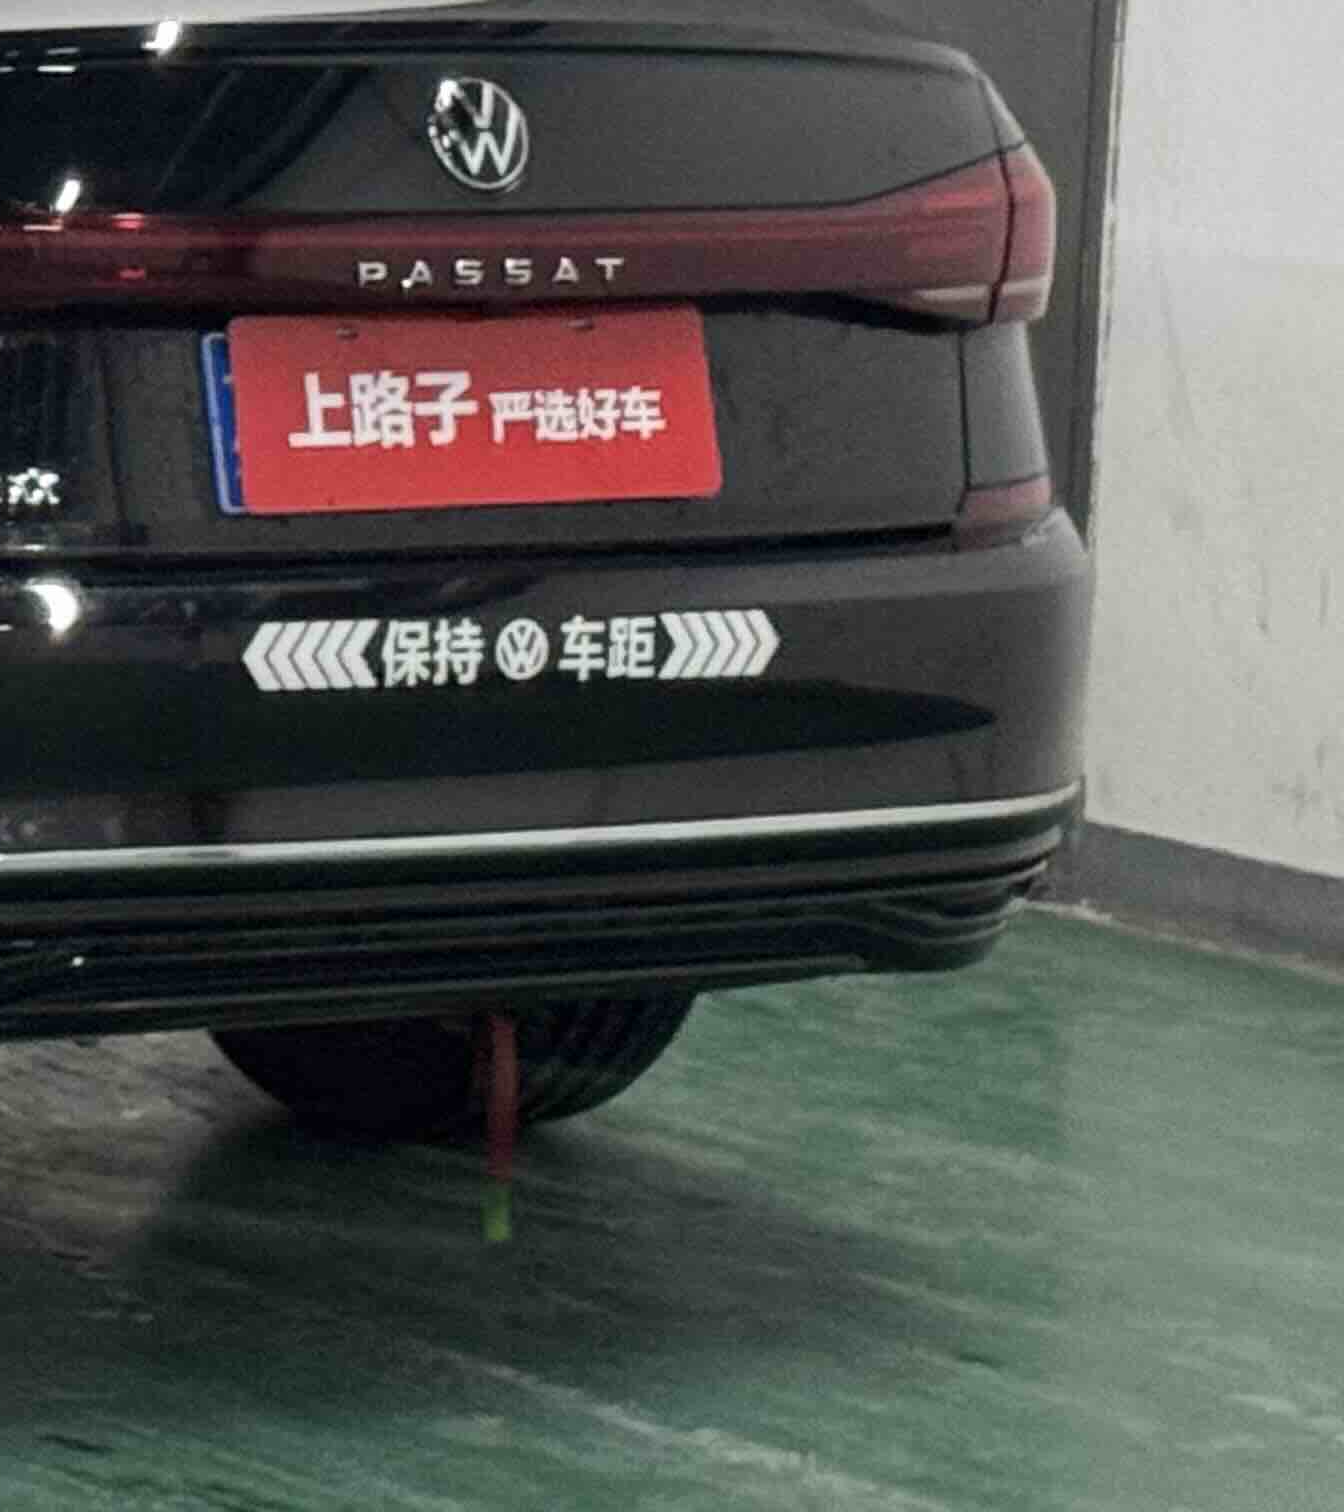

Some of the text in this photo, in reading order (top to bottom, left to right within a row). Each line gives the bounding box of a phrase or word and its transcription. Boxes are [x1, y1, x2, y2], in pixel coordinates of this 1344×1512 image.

[358, 256, 626, 287] PASSAT
[288, 370, 667, 450] 上路子 严选好车
[381, 617, 486, 687] 保持
[558, 614, 656, 682] 车距
